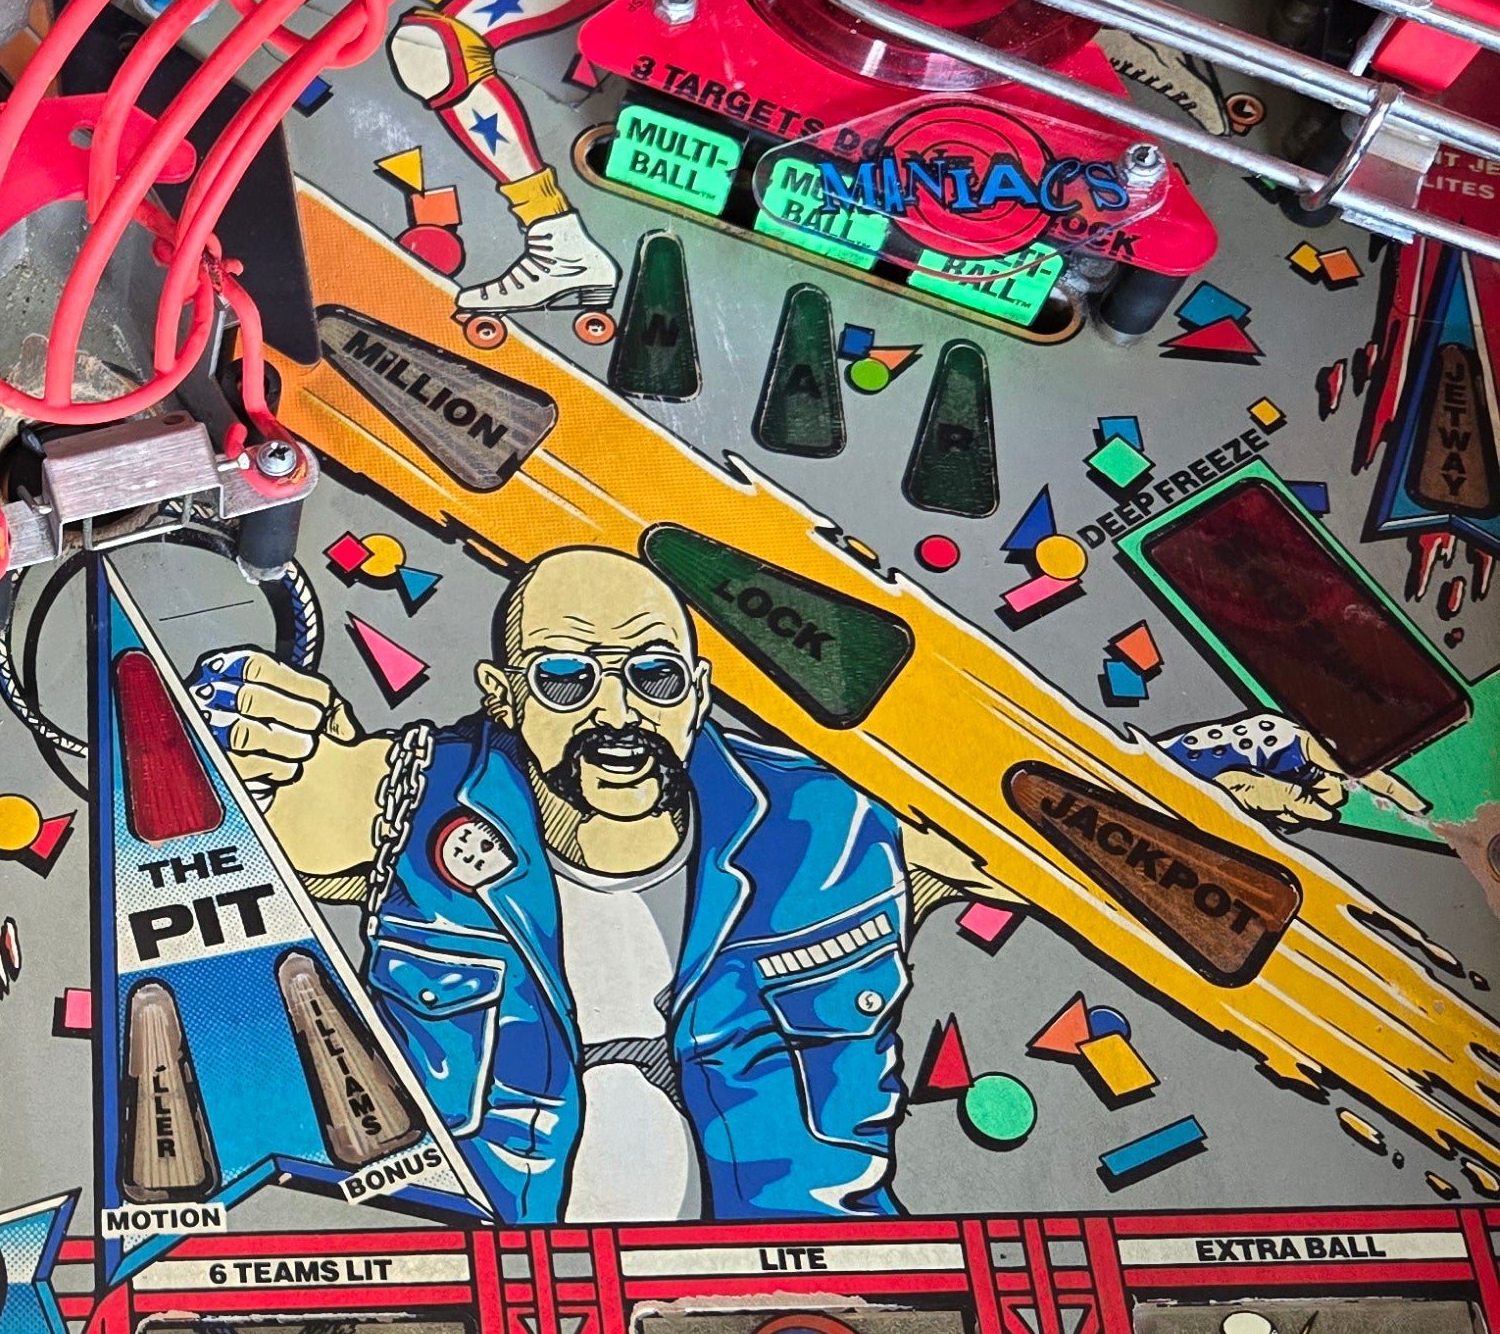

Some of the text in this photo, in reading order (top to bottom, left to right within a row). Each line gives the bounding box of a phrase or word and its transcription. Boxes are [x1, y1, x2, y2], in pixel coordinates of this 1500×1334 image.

[632, 55, 656, 83] 3
[661, 64, 826, 143] TARGETS
[626, 116, 729, 169] MULTI-
[814, 153, 1131, 217] MANIACS
[343, 330, 508, 449] MILLION
[1076, 427, 1270, 549] DEEP FREEZE
[713, 578, 836, 662] LOCK
[138, 846, 244, 889] THE
[1039, 791, 1263, 934] JACKPOT
[127, 885, 274, 962] PIT
[343, 1147, 442, 1199] BONUS
[106, 1207, 222, 1232] MOTION
[209, 1259, 393, 1284] 6 TEAMS LIT
[759, 1248, 828, 1270] LITE
[1196, 1235, 1387, 1263] EXTRA BALL
